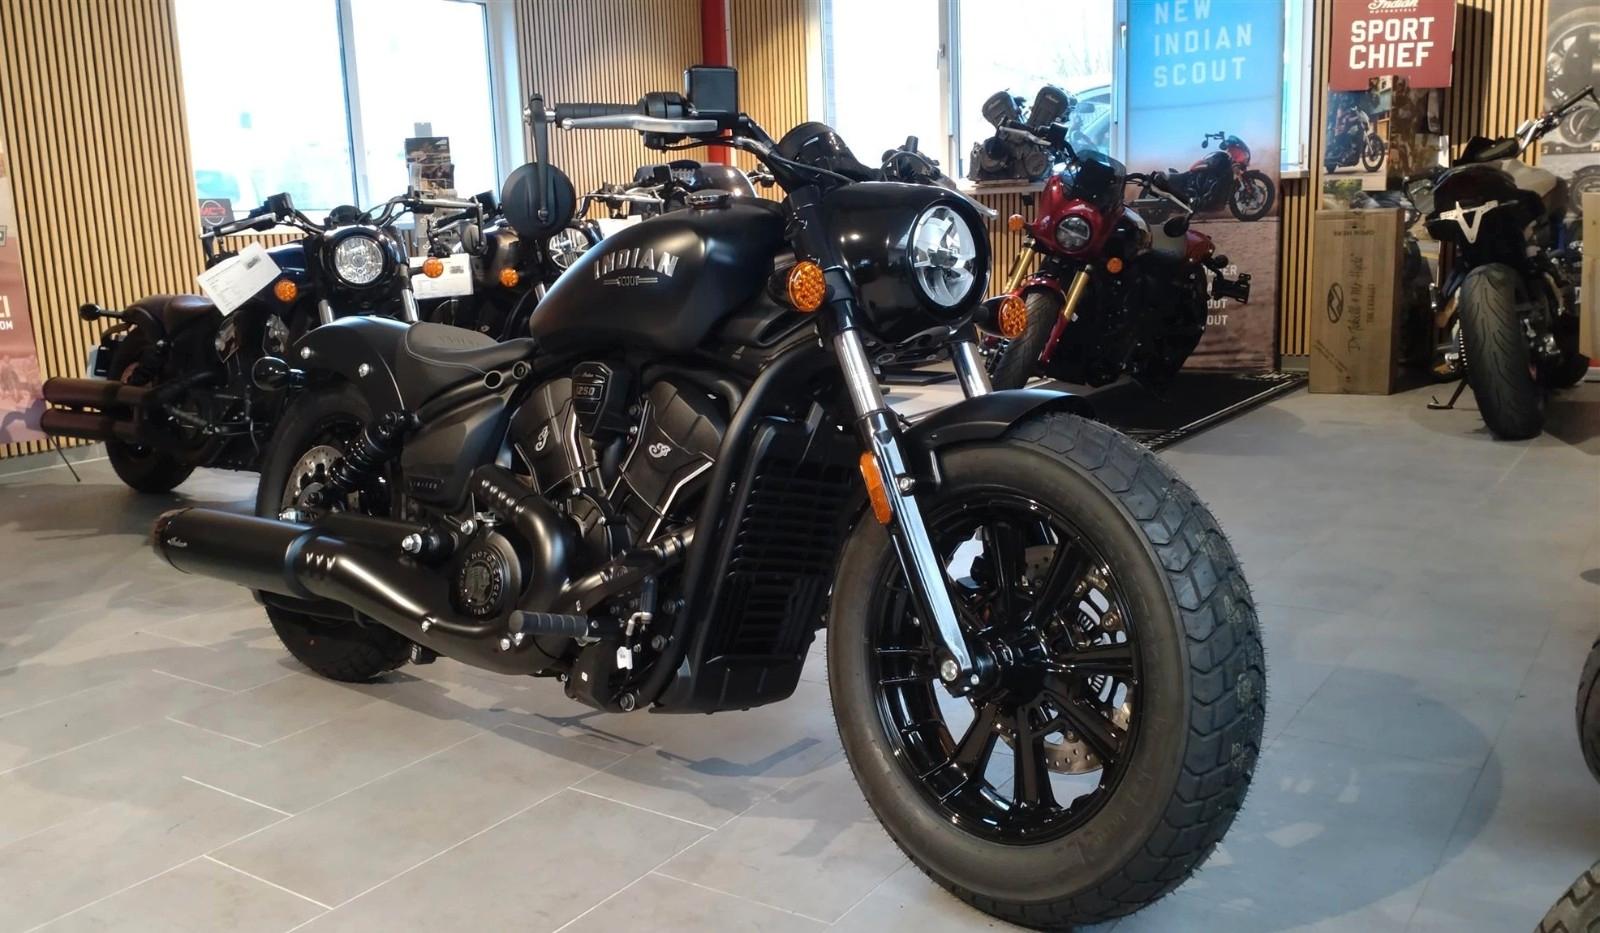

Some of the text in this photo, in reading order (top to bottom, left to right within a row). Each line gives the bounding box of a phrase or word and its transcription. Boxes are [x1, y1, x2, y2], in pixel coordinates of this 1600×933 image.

[1154, 0, 1212, 24] NEW
[1154, 23, 1253, 57] INDIAN
[1350, 16, 1435, 43] SPORT
[1349, 41, 1434, 70] CHIEF
[1153, 57, 1247, 88] SCOUT
[593, 247, 679, 280] INDIAN
